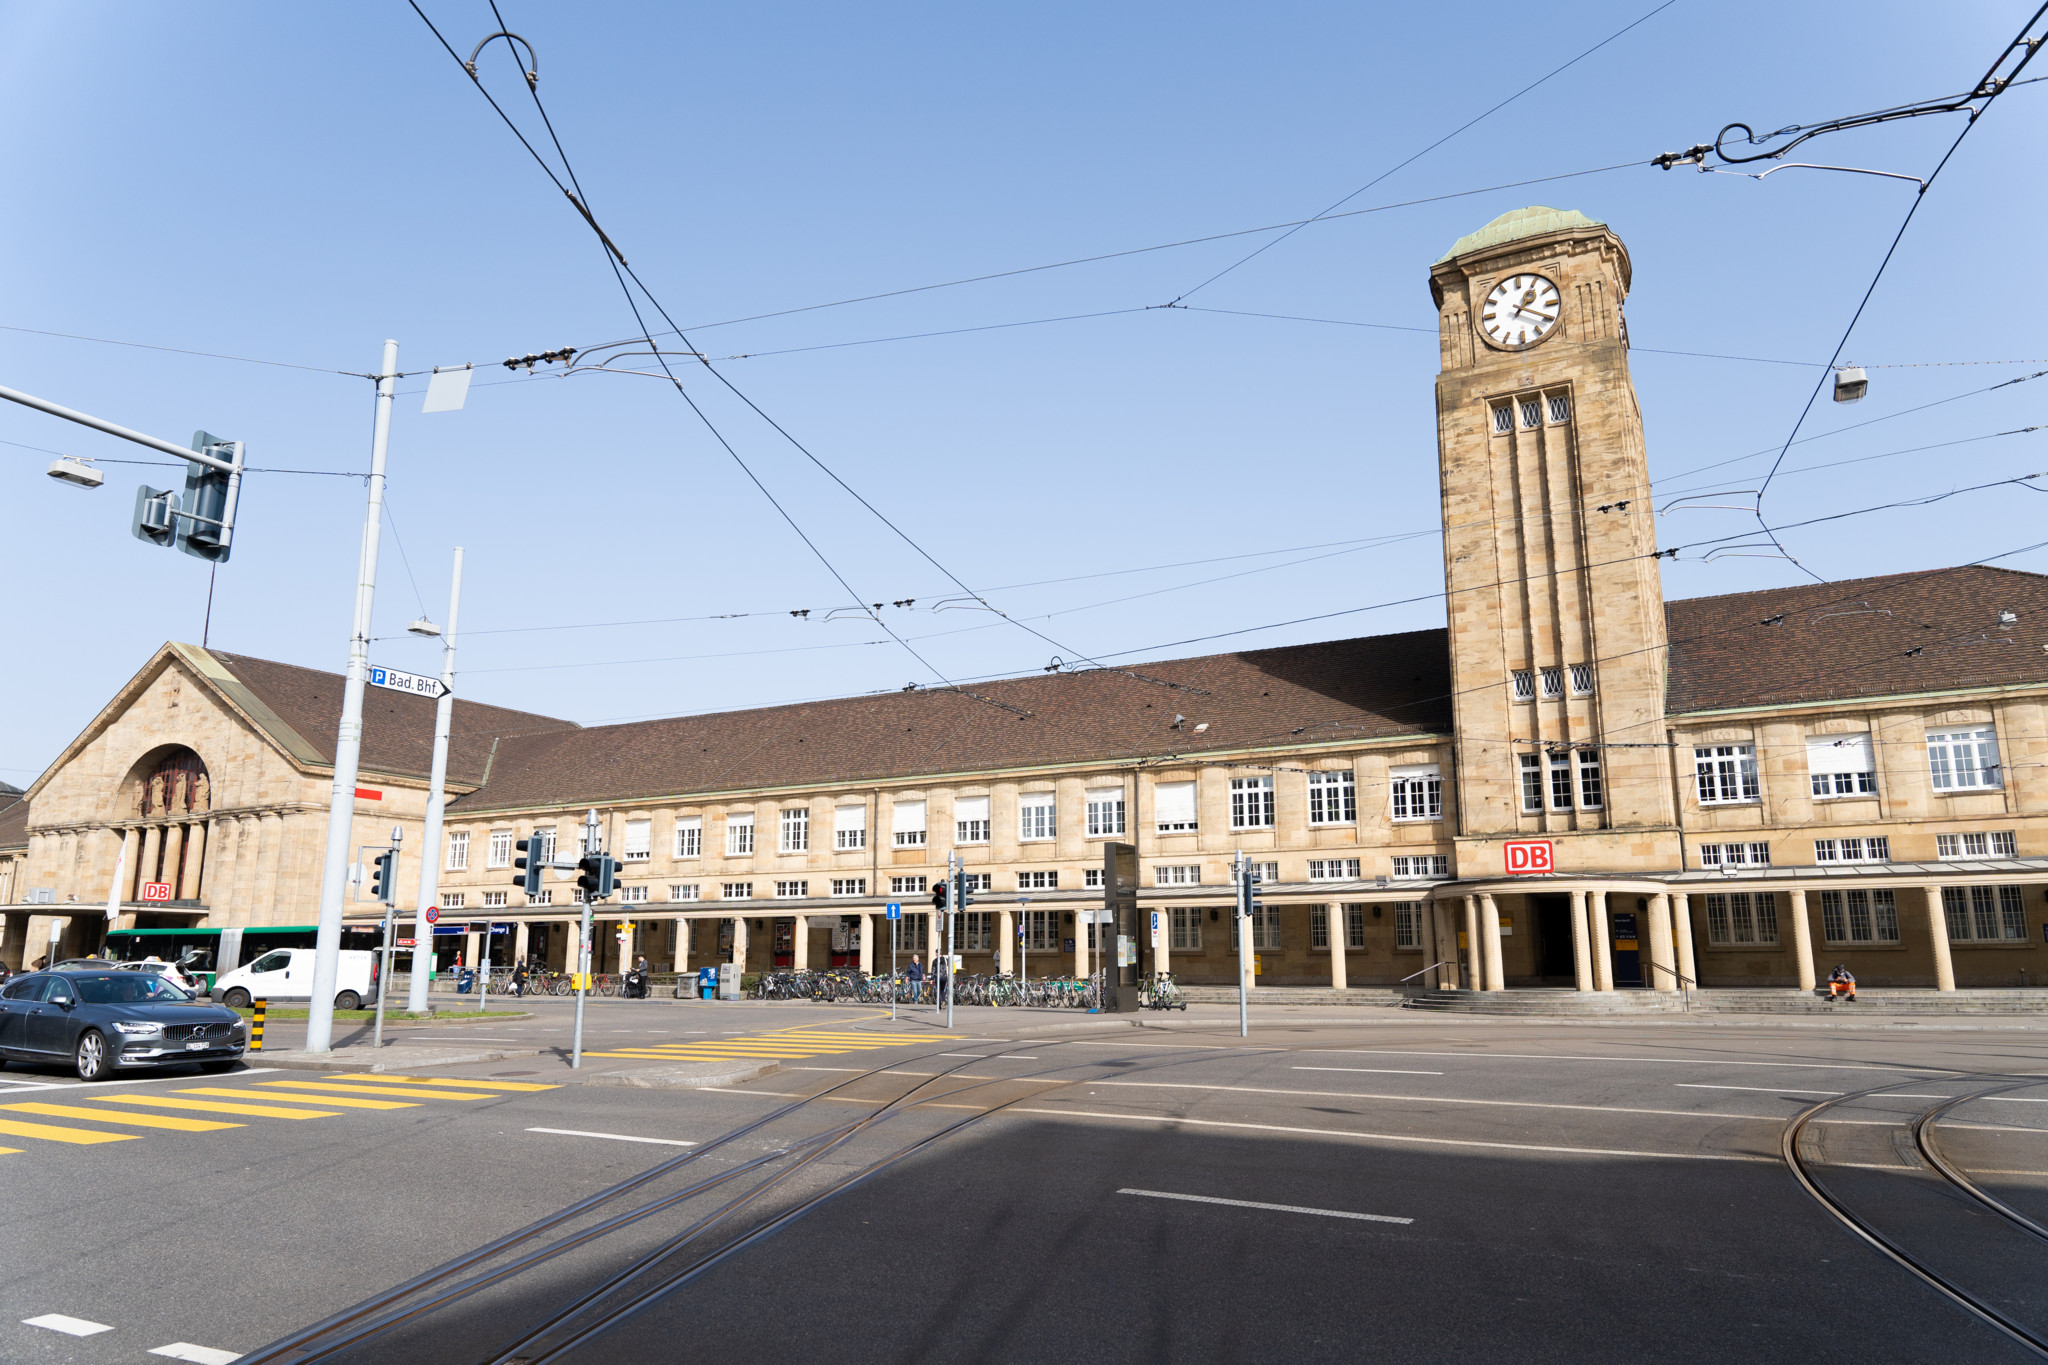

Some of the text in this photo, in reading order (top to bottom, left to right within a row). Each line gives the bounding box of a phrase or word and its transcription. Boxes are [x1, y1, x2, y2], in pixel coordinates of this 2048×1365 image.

[389, 673, 414, 689] Bad.
[416, 679, 438, 694] Bhf.
[1511, 846, 1548, 868] DB
[147, 885, 167, 898] DB
